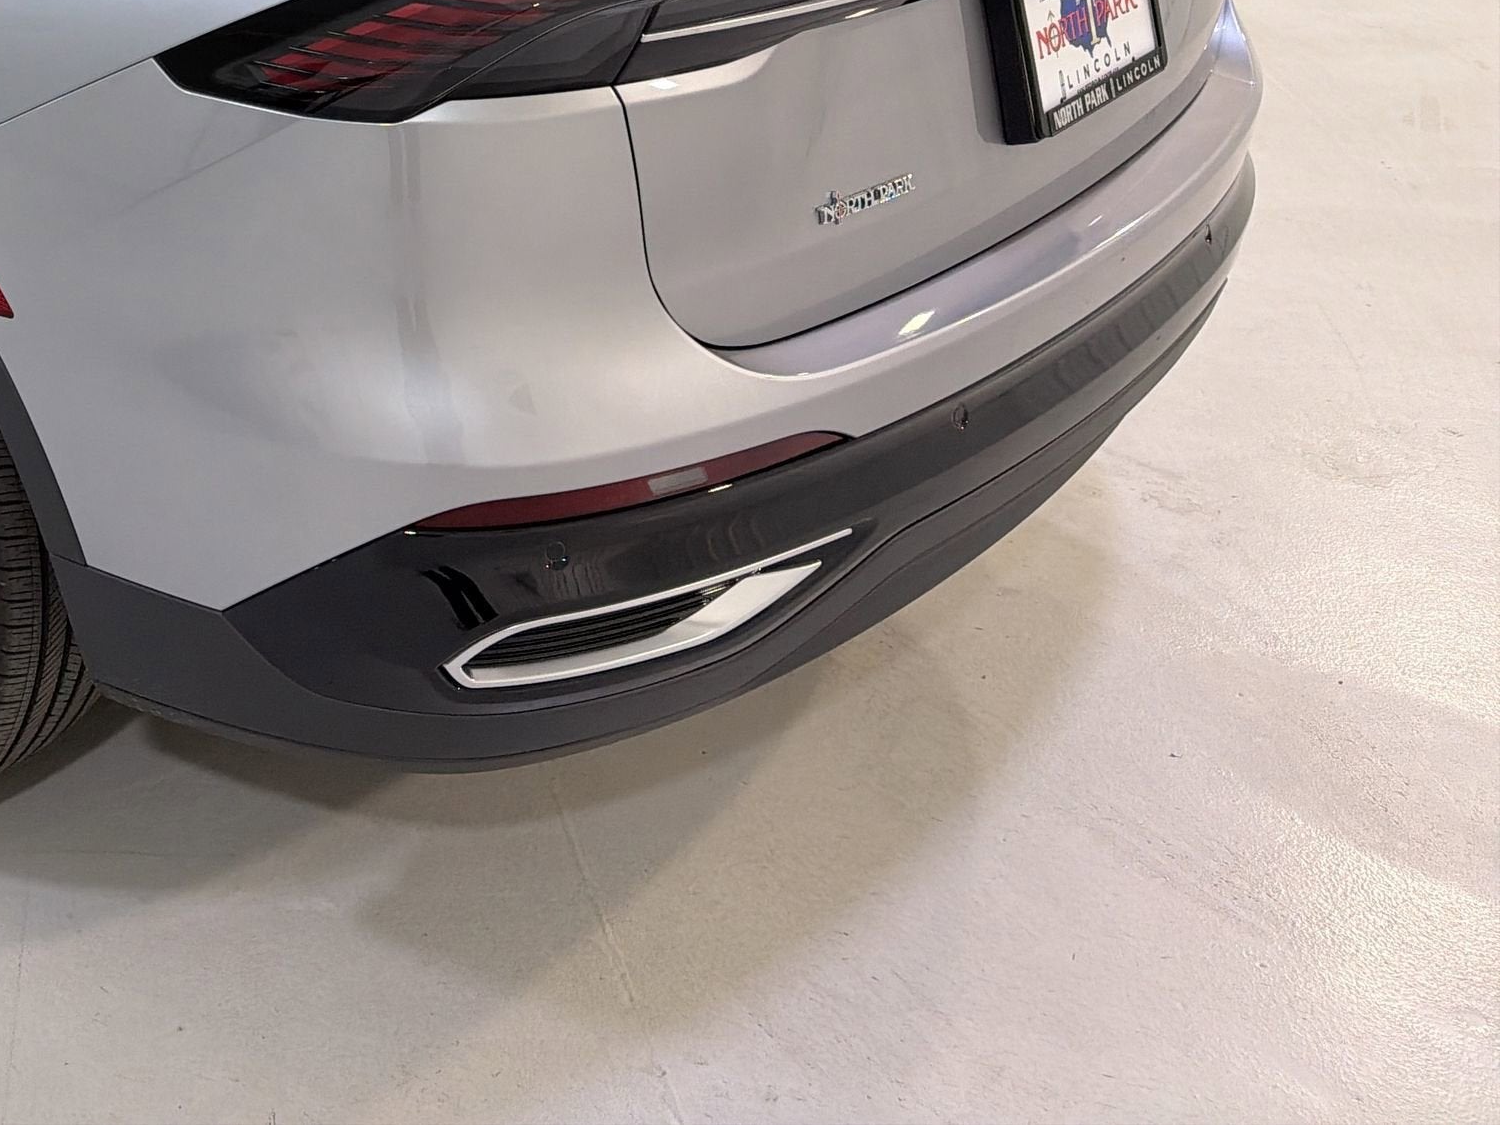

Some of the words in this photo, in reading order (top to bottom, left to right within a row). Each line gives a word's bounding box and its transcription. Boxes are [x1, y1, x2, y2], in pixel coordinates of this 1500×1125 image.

[1036, 6, 1089, 59] NORTH
[1067, 41, 1130, 88] LINCOLN
[1053, 97, 1084, 130] NORTH
[1084, 83, 1109, 112] PARK
[1116, 54, 1161, 91] LINCOLN
[815, 189, 878, 225] NORTH
[879, 173, 916, 203] PARK
